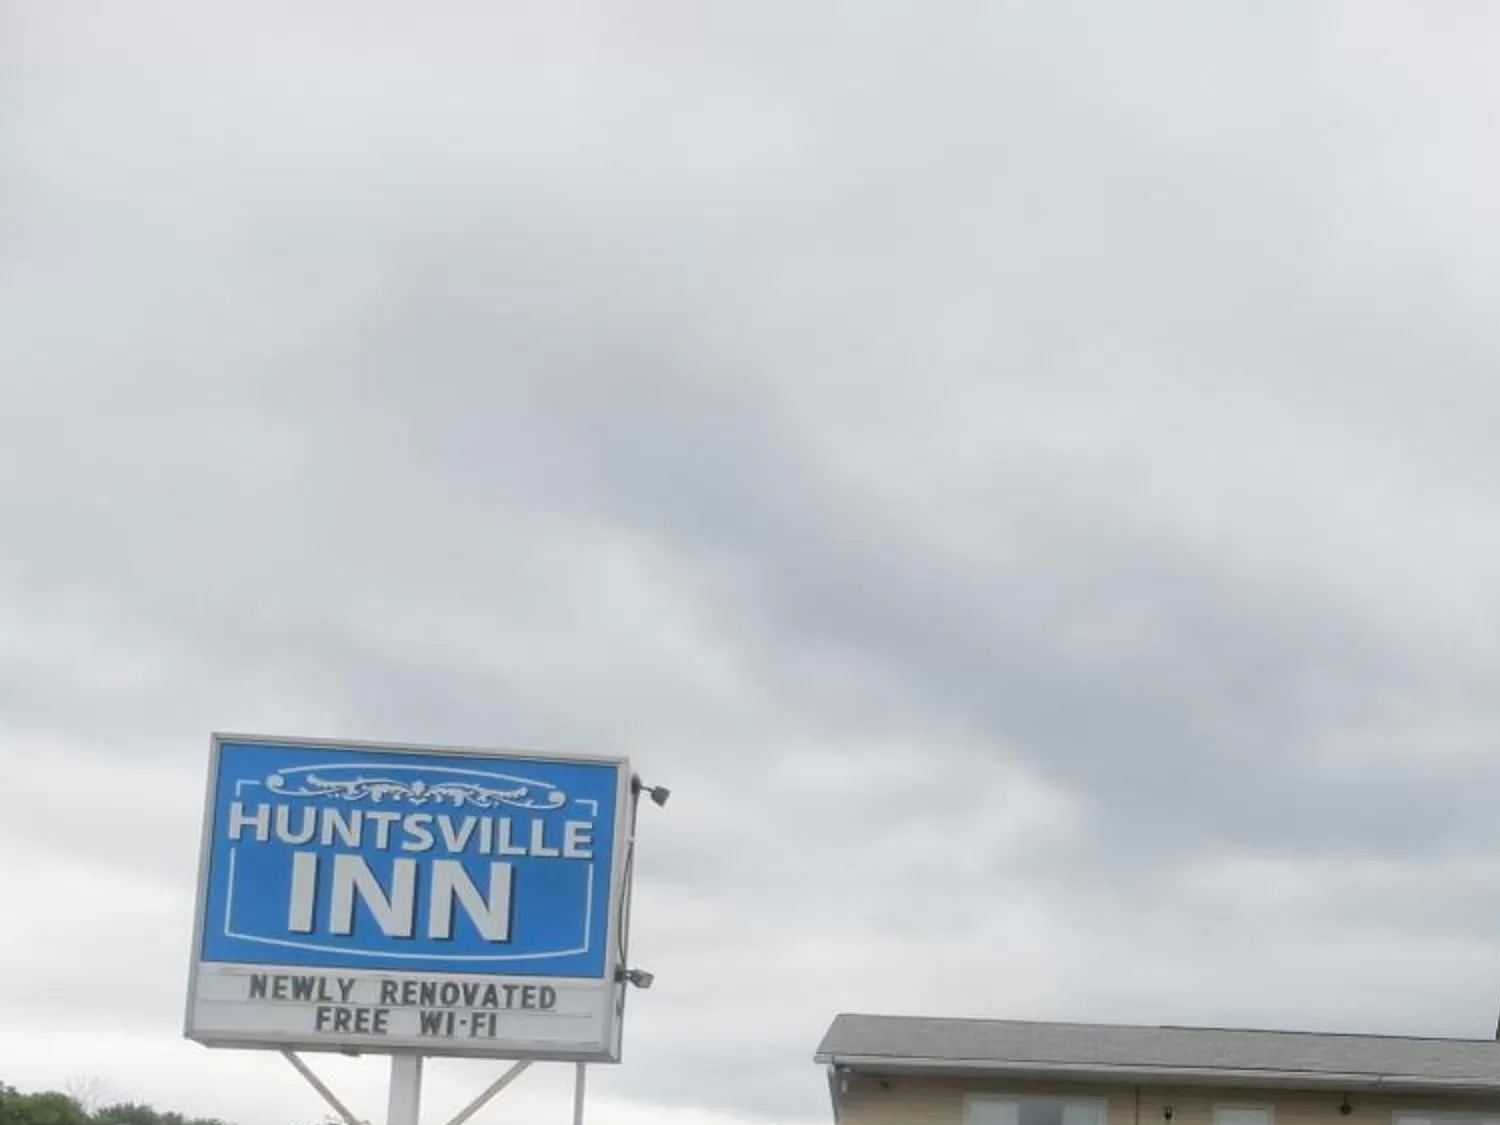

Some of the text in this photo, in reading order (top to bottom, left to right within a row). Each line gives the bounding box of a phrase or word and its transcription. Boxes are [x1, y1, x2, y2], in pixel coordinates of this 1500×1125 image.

[228, 801, 594, 859] HUNTSVILLE
[287, 851, 512, 943] INN
[248, 973, 557, 1010] NEWLY RENOVATED
[315, 1006, 498, 1038] FREE WI-FI
